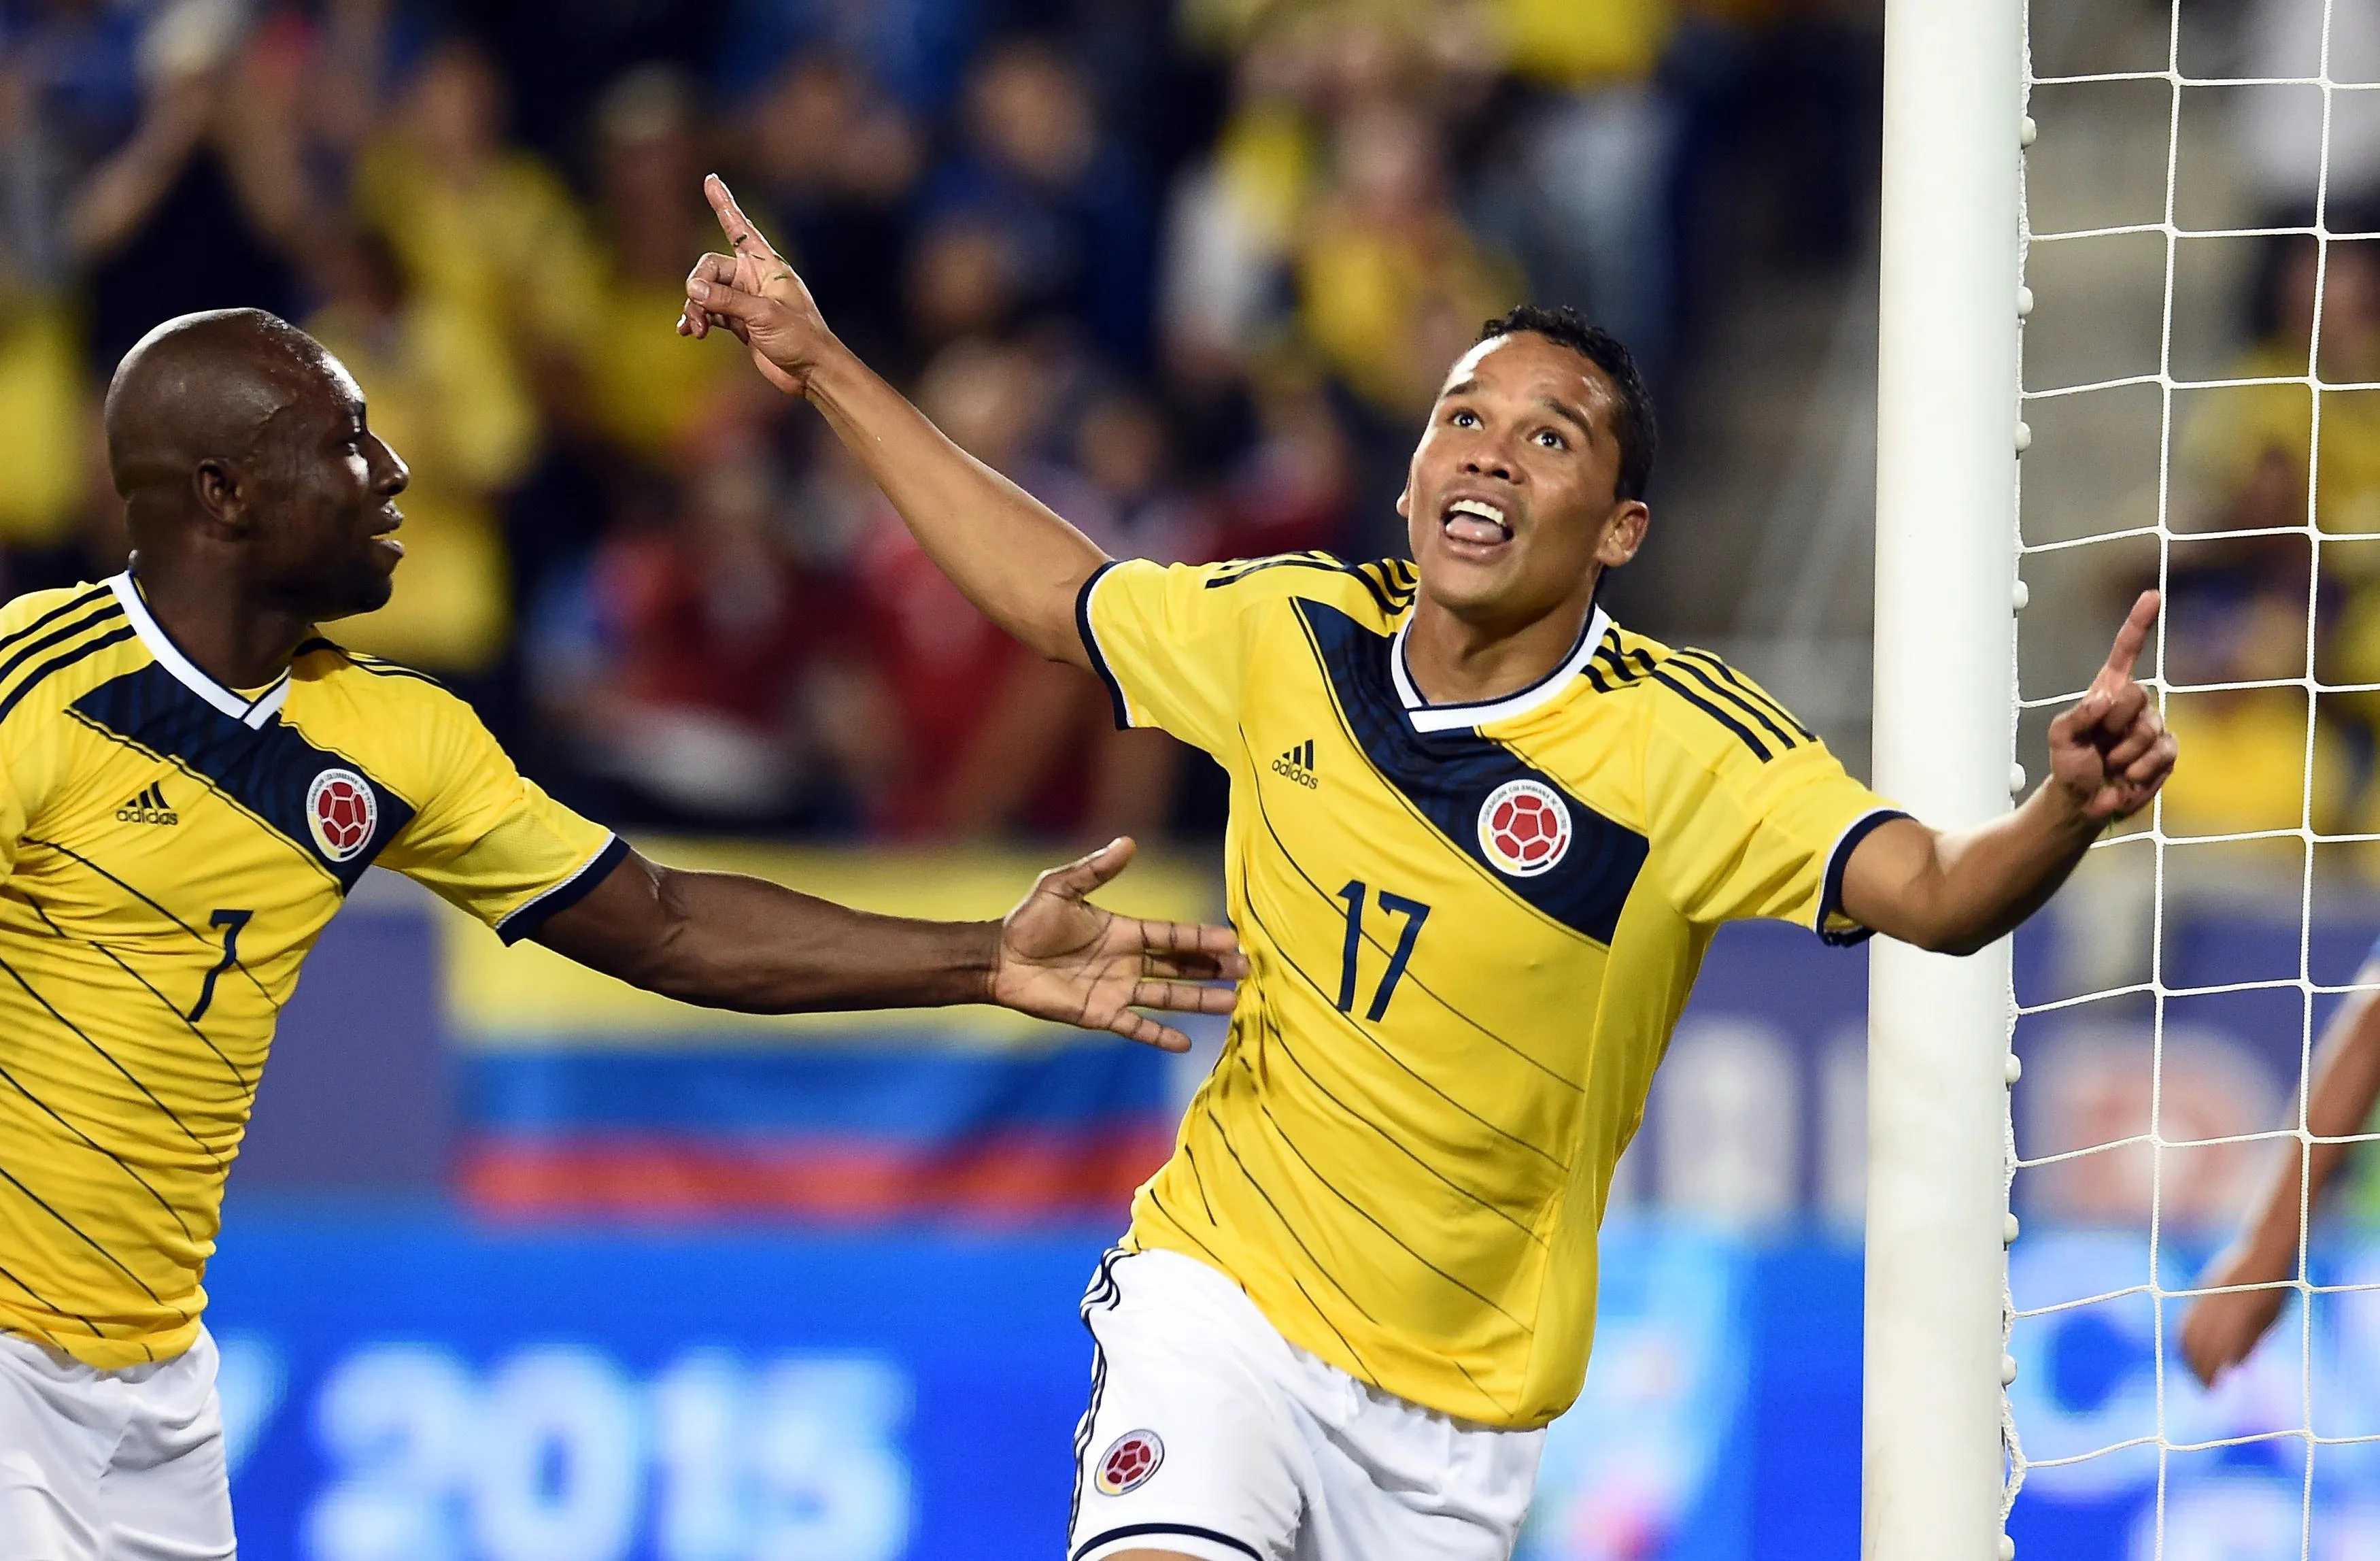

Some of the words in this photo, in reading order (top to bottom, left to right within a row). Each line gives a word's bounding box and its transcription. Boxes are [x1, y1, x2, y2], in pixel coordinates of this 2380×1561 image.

[116, 809, 179, 826] adidas
[1270, 758, 1319, 790] adidas
[186, 909, 254, 1023] 7
[1336, 879, 1432, 1023] 17
[306, 1341, 910, 1561] 2015
